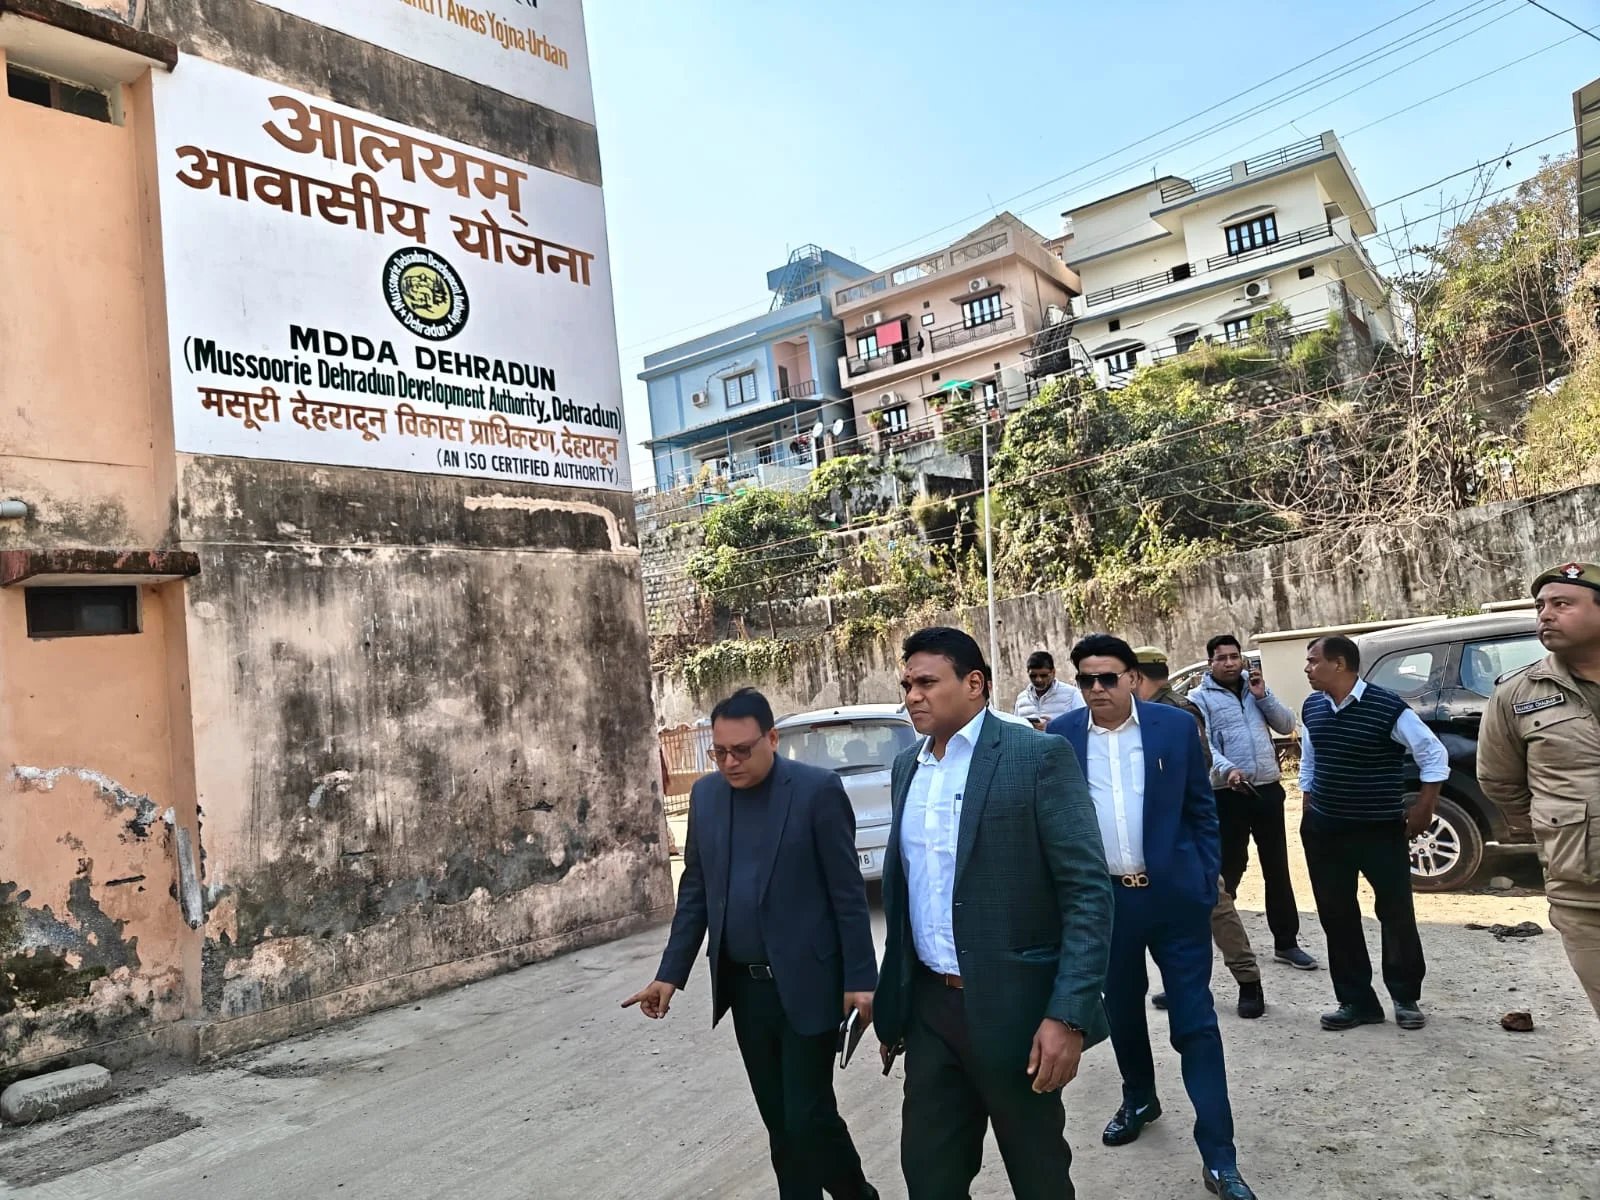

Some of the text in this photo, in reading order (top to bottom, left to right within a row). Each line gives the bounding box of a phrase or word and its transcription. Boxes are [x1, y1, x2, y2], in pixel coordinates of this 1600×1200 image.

[447, 0, 487, 35] Awas
[262, 95, 528, 227] आलयम्
[175, 145, 595, 286] आवासीय योजना
[289, 324, 557, 392] MDDA DEHRADUN
[404, 313, 448, 337] Dehradun
[183, 335, 622, 434] (Mussoorie Dehradun Development Authority, Dehradun)
[197, 386, 282, 432] मसूरी
[289, 390, 388, 442] देहरादून
[394, 402, 466, 442] विकास
[560, 425, 619, 466] देहरादून
[436, 448, 460, 469] (AN
[464, 452, 487, 471] ISO
[491, 455, 550, 477] CERTIFIED
[553, 464, 619, 485] AUTHORITY)
